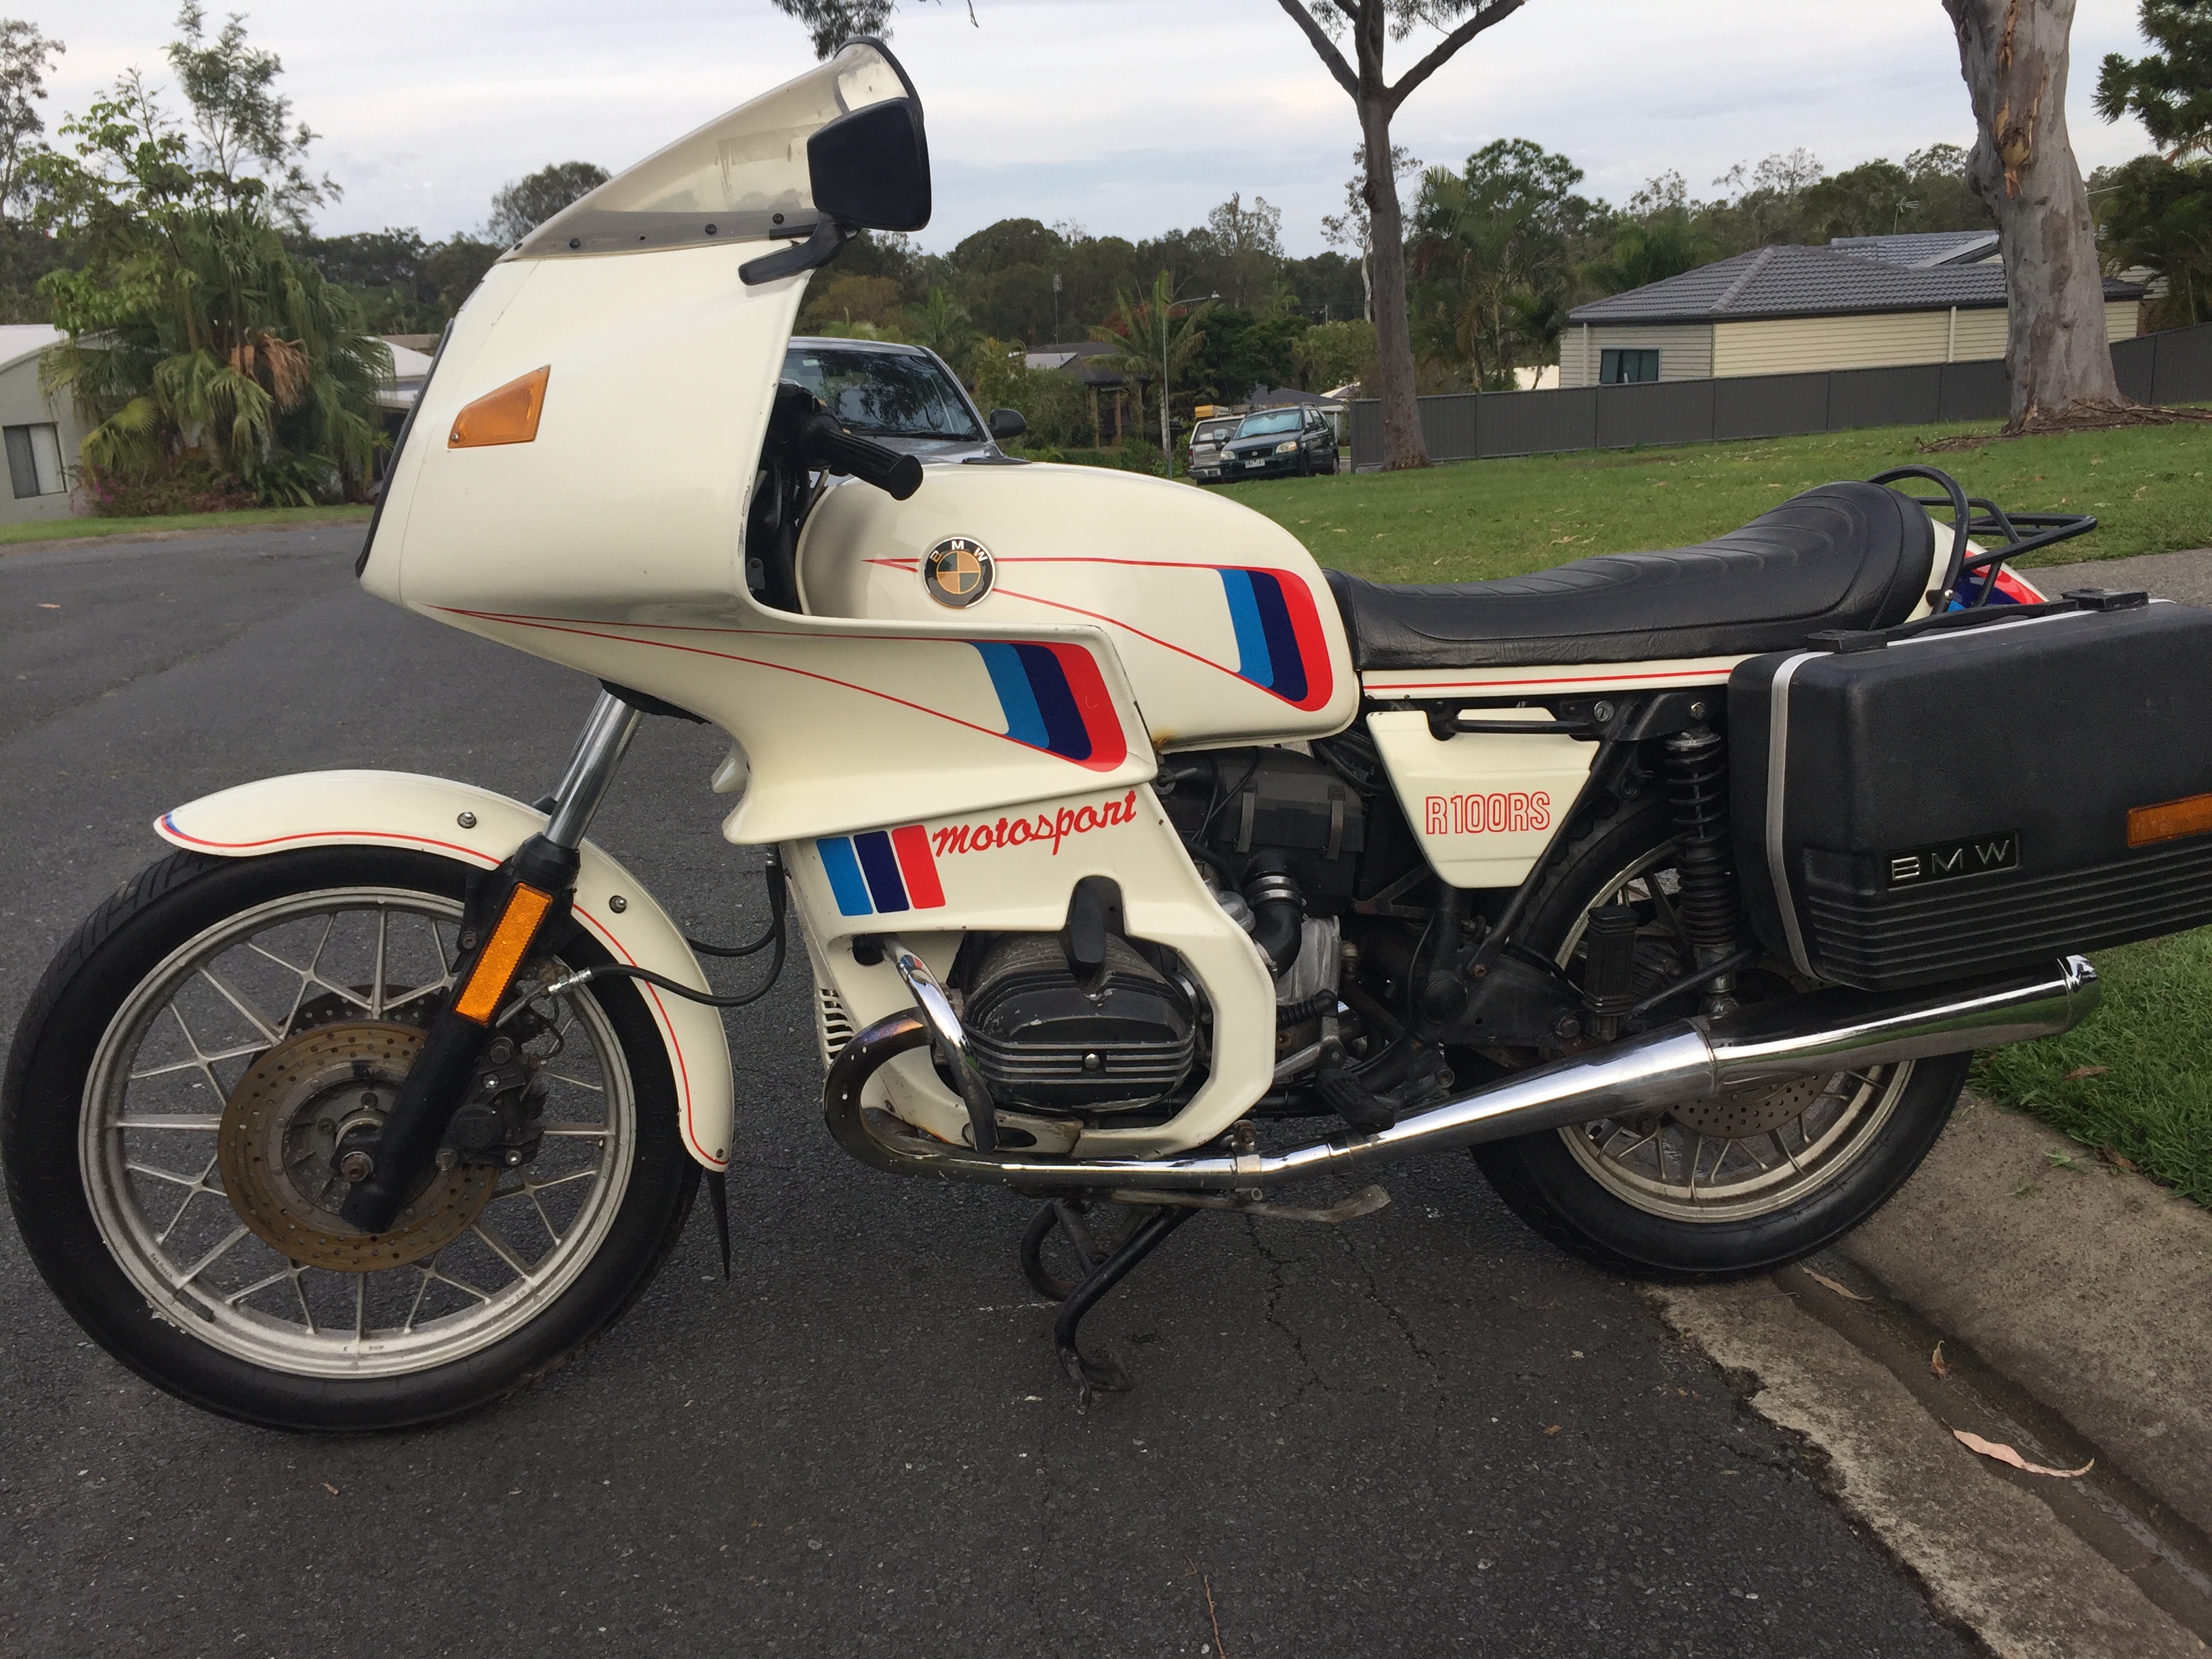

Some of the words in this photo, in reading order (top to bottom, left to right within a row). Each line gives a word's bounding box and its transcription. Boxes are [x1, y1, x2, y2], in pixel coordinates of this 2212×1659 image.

[929, 540, 988, 562] BMW
[933, 790, 1136, 857] motosport
[1426, 792, 1550, 835] R100RS
[1891, 840, 2011, 881] BMW
